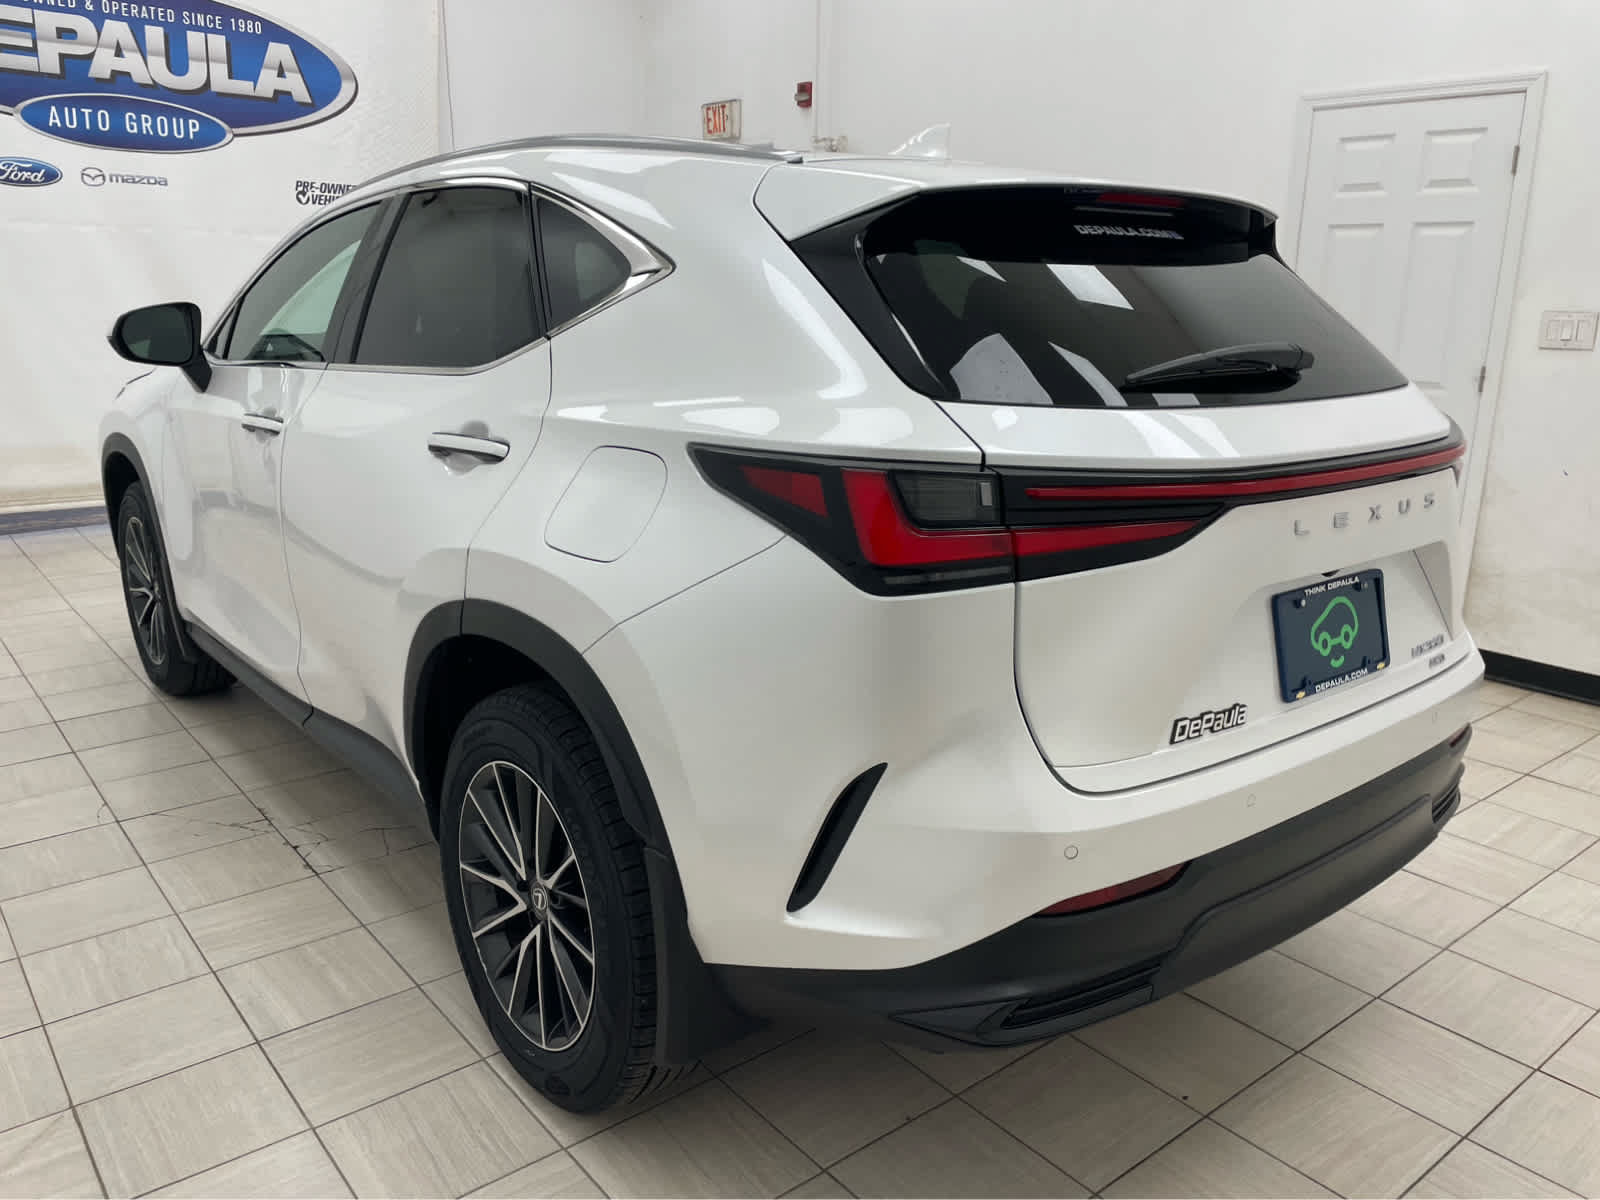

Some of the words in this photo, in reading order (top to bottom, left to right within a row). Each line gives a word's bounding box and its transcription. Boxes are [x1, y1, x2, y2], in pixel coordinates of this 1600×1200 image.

[85, 0, 95, 11] &
[102, 0, 175, 22] OPERATED
[182, 11, 223, 29] SINCE
[230, 18, 262, 34] 1980
[48, 106, 110, 131] AUTO
[125, 112, 200, 140] GROUP
[706, 104, 727, 134] EXIT
[0, 161, 46, 182] Ford
[296, 181, 357, 194] PRE-OWNE
[1294, 492, 1435, 537] LEXUS
[1304, 584, 1326, 597] THINK
[1328, 576, 1360, 590] DEPAULA
[1315, 667, 1368, 692] DEPAULA.COM
[1169, 702, 1247, 745] DePaula
